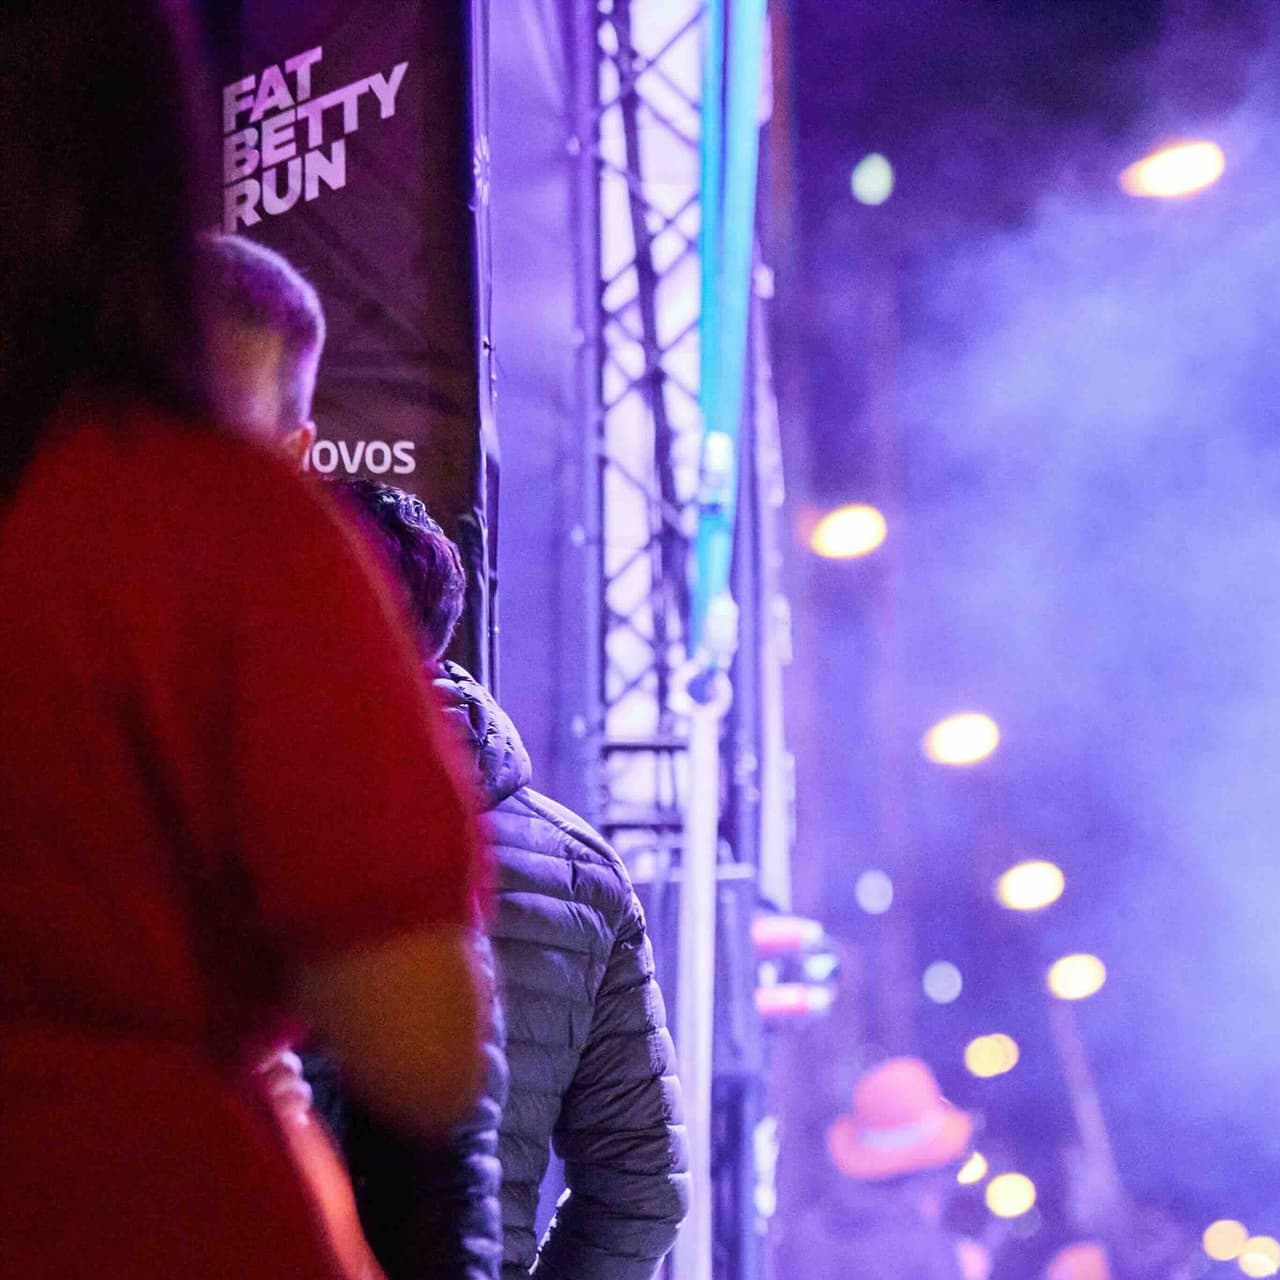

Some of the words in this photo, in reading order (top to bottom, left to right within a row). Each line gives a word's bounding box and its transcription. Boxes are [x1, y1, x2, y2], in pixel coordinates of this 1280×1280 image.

[222, 46, 323, 133] FAT
[223, 61, 409, 185] BETTY
[222, 139, 346, 235] RUN
